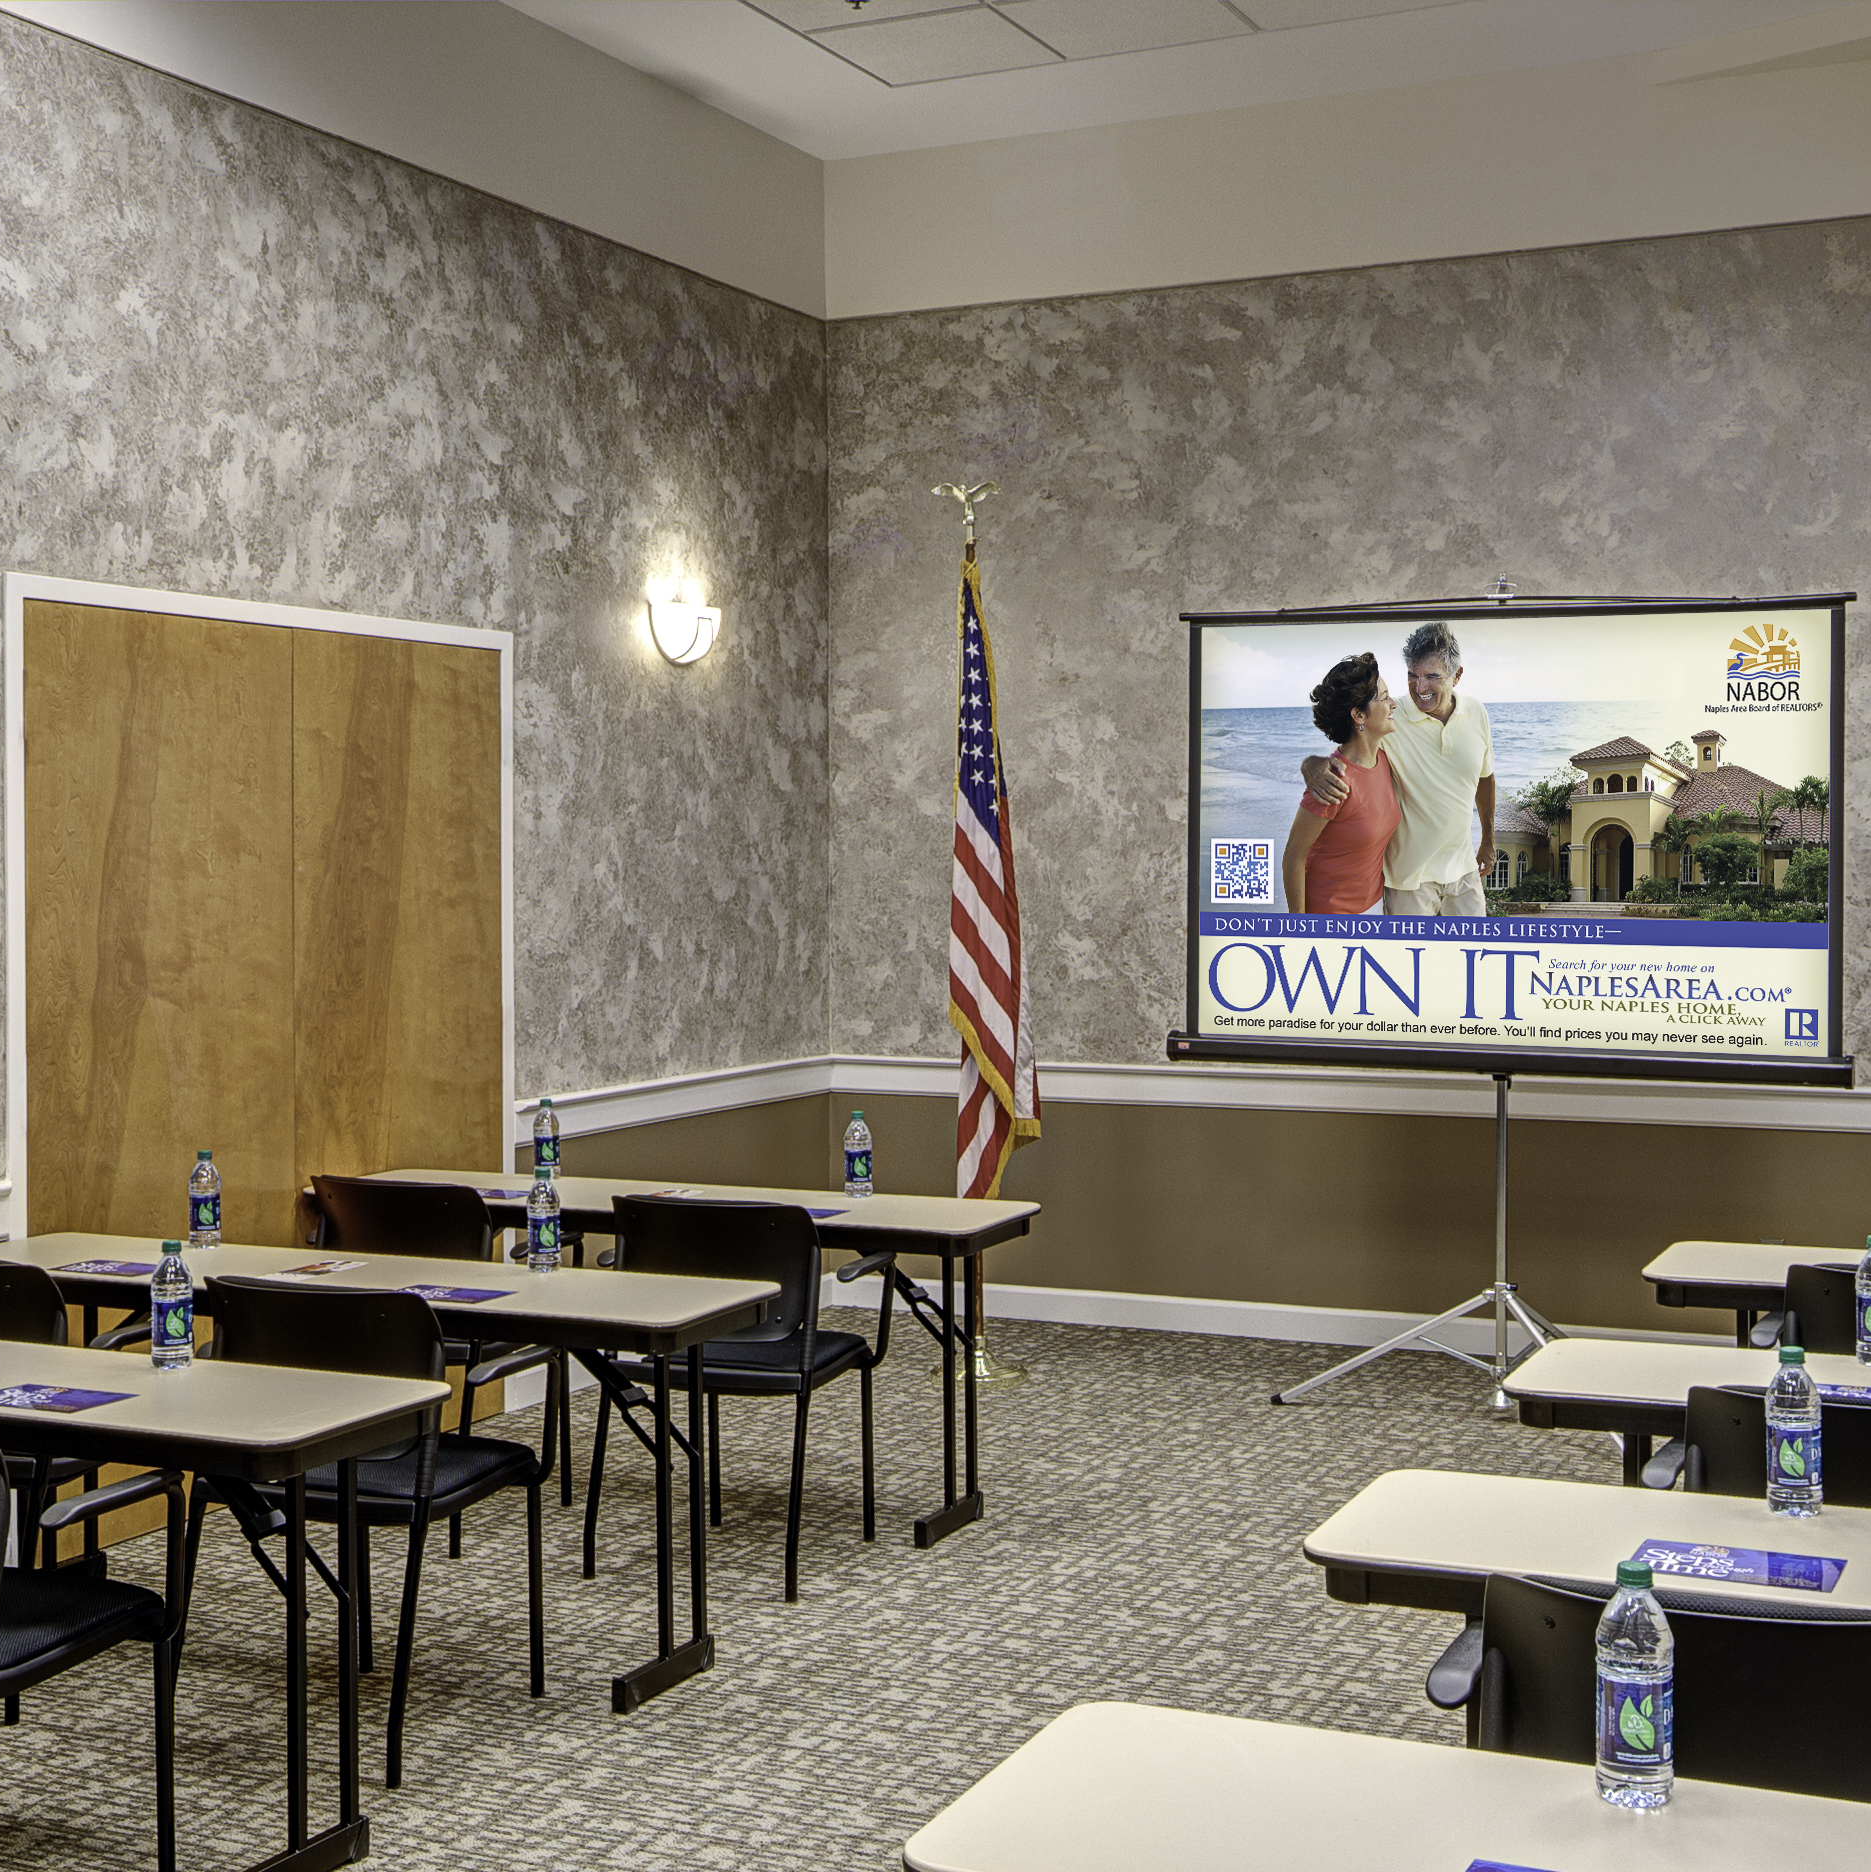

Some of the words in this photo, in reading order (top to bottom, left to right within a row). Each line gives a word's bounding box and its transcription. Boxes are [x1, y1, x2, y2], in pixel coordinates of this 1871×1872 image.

[1727, 682, 1800, 701] NABOR
[1704, 704, 1730, 714] Naples
[1731, 704, 1748, 713] Area
[1749, 703, 1771, 712] Board
[1771, 703, 1782, 712] of
[1214, 917, 1273, 932] DON'T
[1278, 918, 1319, 935] JUST
[1325, 919, 1383, 937] ENJOY
[1389, 921, 1426, 935] THE
[1433, 922, 1501, 937] NAPLES
[1548, 958, 1587, 970] Search
[1587, 959, 1608, 973] for
[1608, 963, 1637, 973] your
[1639, 963, 1663, 972] new
[1665, 961, 1698, 973] home
[1700, 965, 1715, 973] on
[1208, 942, 1426, 1018] OWN
[1459, 948, 1540, 1021] IT
[1540, 997, 1595, 1011] YOUR
[1601, 999, 1670, 1014] NAPLES
[1677, 1002, 1744, 1020] HOME,
[1666, 1014, 1677, 1024] A
[1678, 1014, 1724, 1025] CLICK
[1726, 1015, 1766, 1026] AWAY
[1213, 1015, 1235, 1026] Get
[1236, 1018, 1266, 1028] more
[1268, 1017, 1317, 1031] paradise
[1319, 1018, 1336, 1030] for
[1337, 1021, 1364, 1033] your
[1366, 1020, 1399, 1032] dollar
[1400, 1021, 1427, 1033] than
[1429, 1024, 1457, 1035] ever
[1459, 1023, 1501, 1036] before.
[1503, 1024, 1536, 1038] You'll
[1539, 1026, 1562, 1038] find
[1565, 1027, 1602, 1042] prices
[1604, 1031, 1628, 1043] you
[1631, 1032, 1659, 1045] may
[1662, 1033, 1698, 1044] never
[1701, 1034, 1725, 1044] see
[1728, 1033, 1768, 1048] again.
